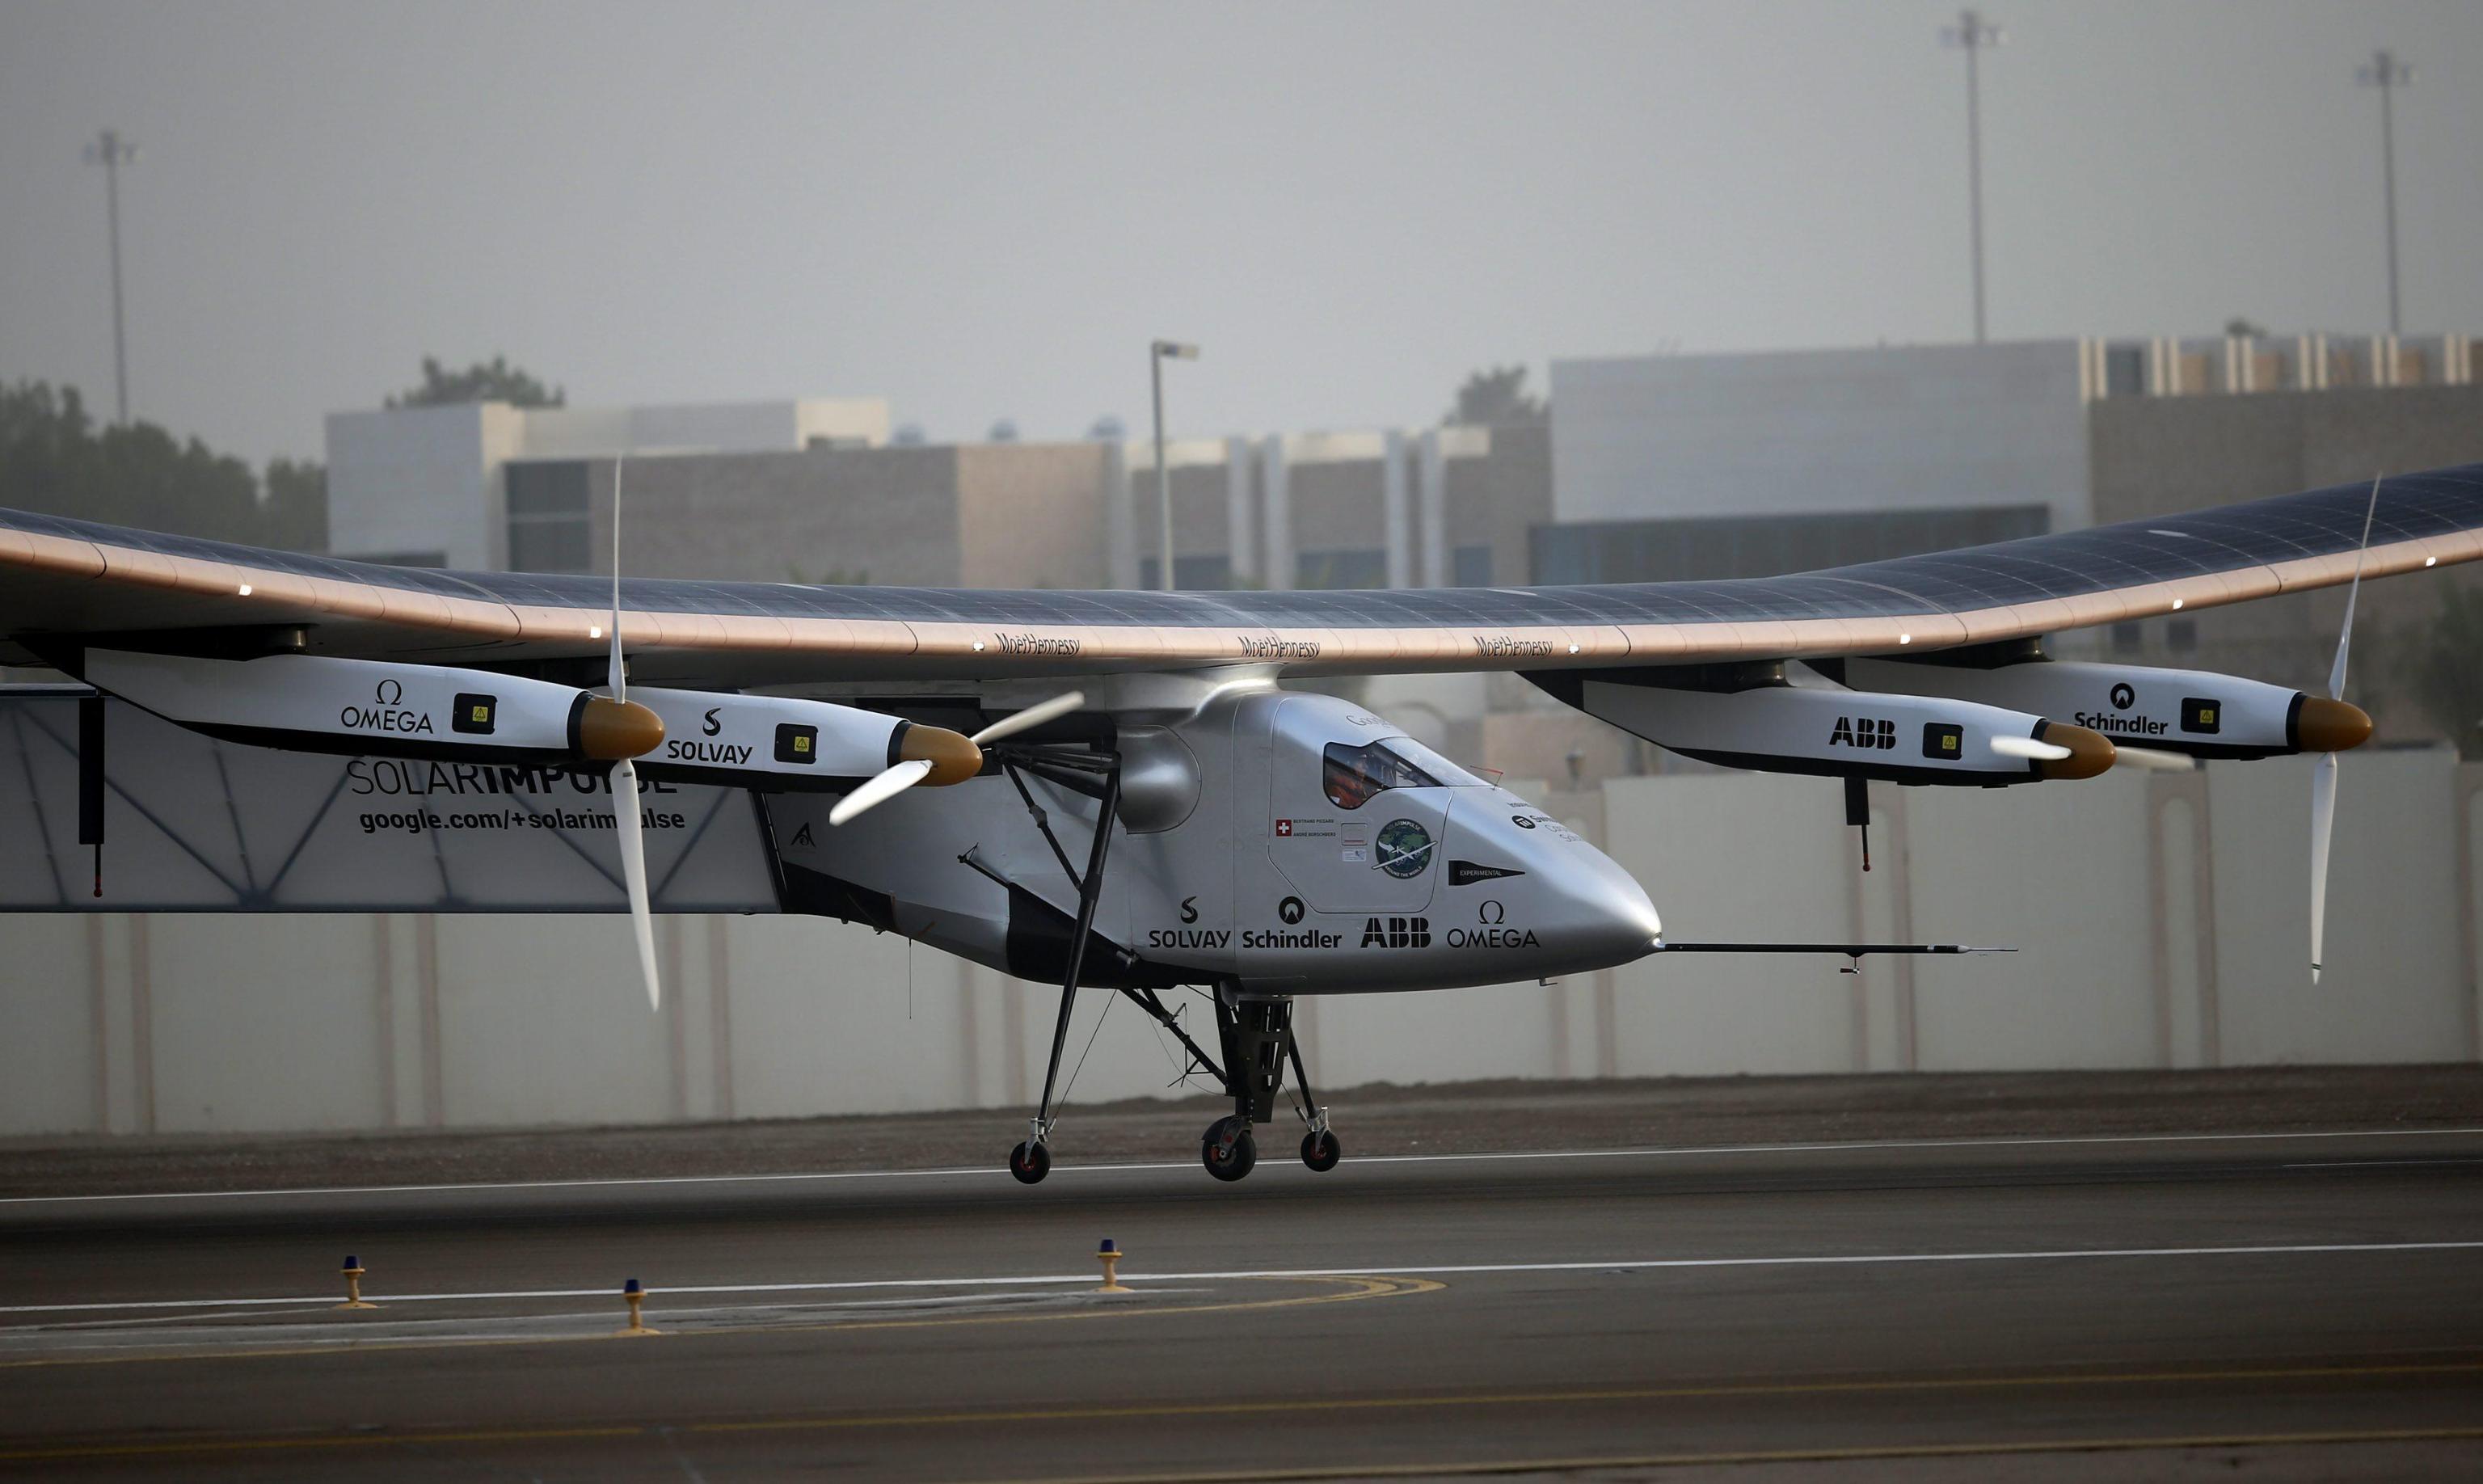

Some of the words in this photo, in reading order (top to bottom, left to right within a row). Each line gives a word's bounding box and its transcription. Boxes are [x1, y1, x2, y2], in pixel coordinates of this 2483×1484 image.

[340, 706, 434, 734] OMEGA
[2073, 711, 2169, 736] Schindler
[1828, 716, 1896, 750] ABB
[667, 740, 753, 765] SOLVAY
[346, 760, 677, 795] SOLARIMPU
[359, 808, 685, 833] google.com/+solarimlse
[1149, 930, 1231, 948] SOLVAY
[1242, 929, 1343, 949] Schindler
[1360, 917, 1431, 948] ABB
[1447, 928, 1541, 948] OMEGA
